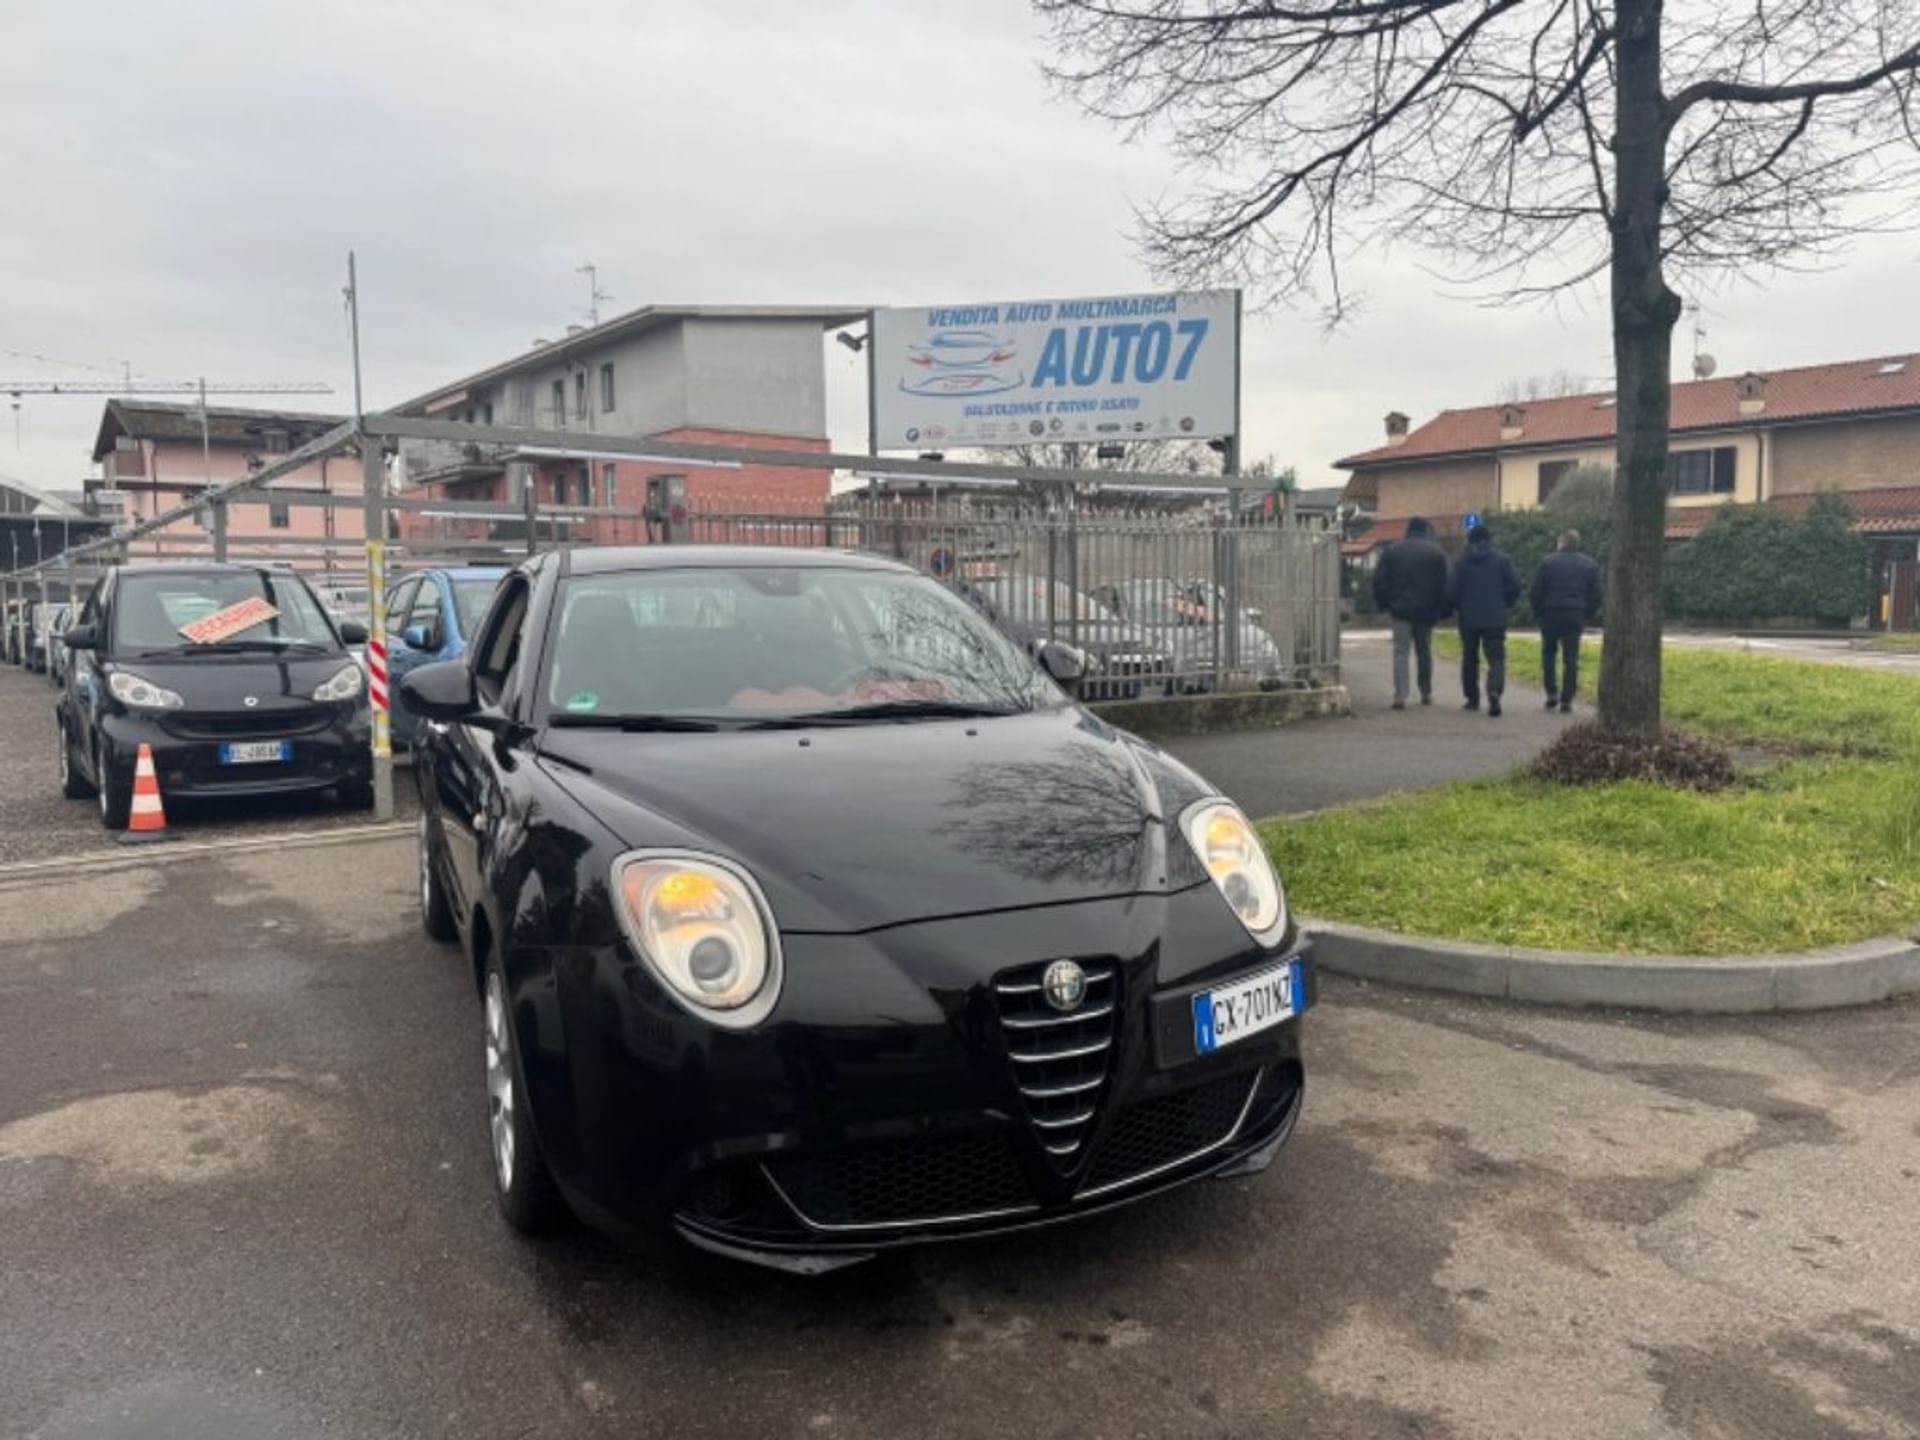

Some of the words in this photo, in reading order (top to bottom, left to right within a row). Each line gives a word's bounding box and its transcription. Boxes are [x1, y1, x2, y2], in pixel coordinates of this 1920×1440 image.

[928, 307, 998, 327] VENDITA
[1006, 303, 1052, 323] AUTO
[1057, 296, 1177, 320] MULTIMARCA
[1030, 319, 1208, 389] AUTO7
